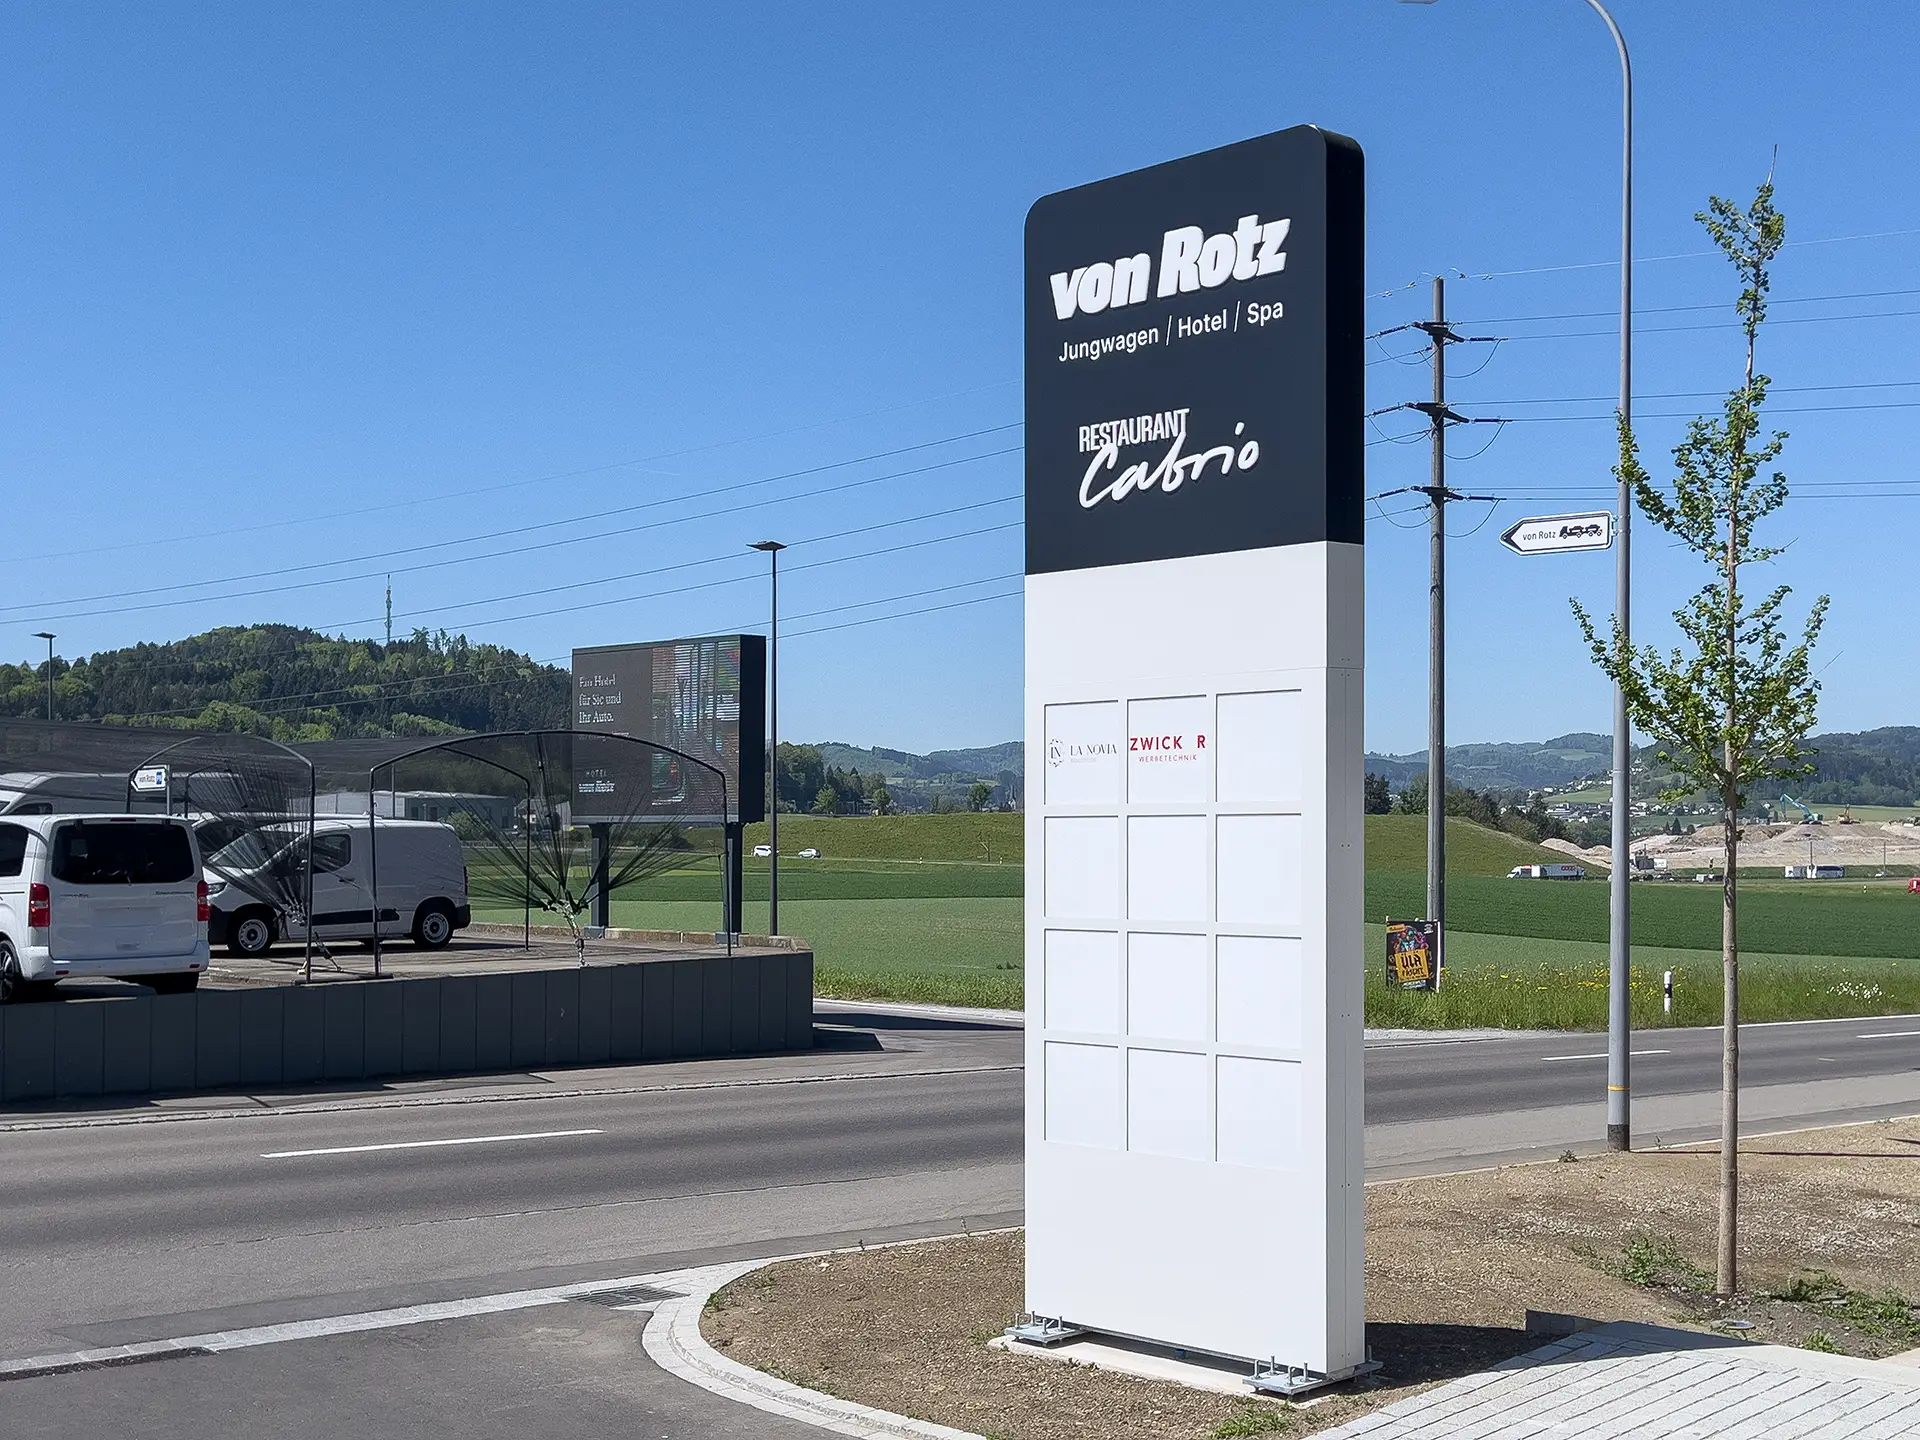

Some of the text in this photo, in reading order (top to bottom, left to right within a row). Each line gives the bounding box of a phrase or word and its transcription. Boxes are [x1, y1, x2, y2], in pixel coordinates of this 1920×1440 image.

[1050, 214, 1291, 320] von Rotz
[1058, 326, 1159, 362] Jungwagen
[1177, 308, 1227, 338] Hotel
[1247, 301, 1284, 326] Spa
[1078, 407, 1190, 453] RESTAURANT
[1078, 421, 1260, 508] Cabrio
[1522, 530, 1557, 541] von Rotz
[1070, 743, 1118, 756] LA NOVIA
[1138, 754, 1197, 763] WERBETECHNIK
